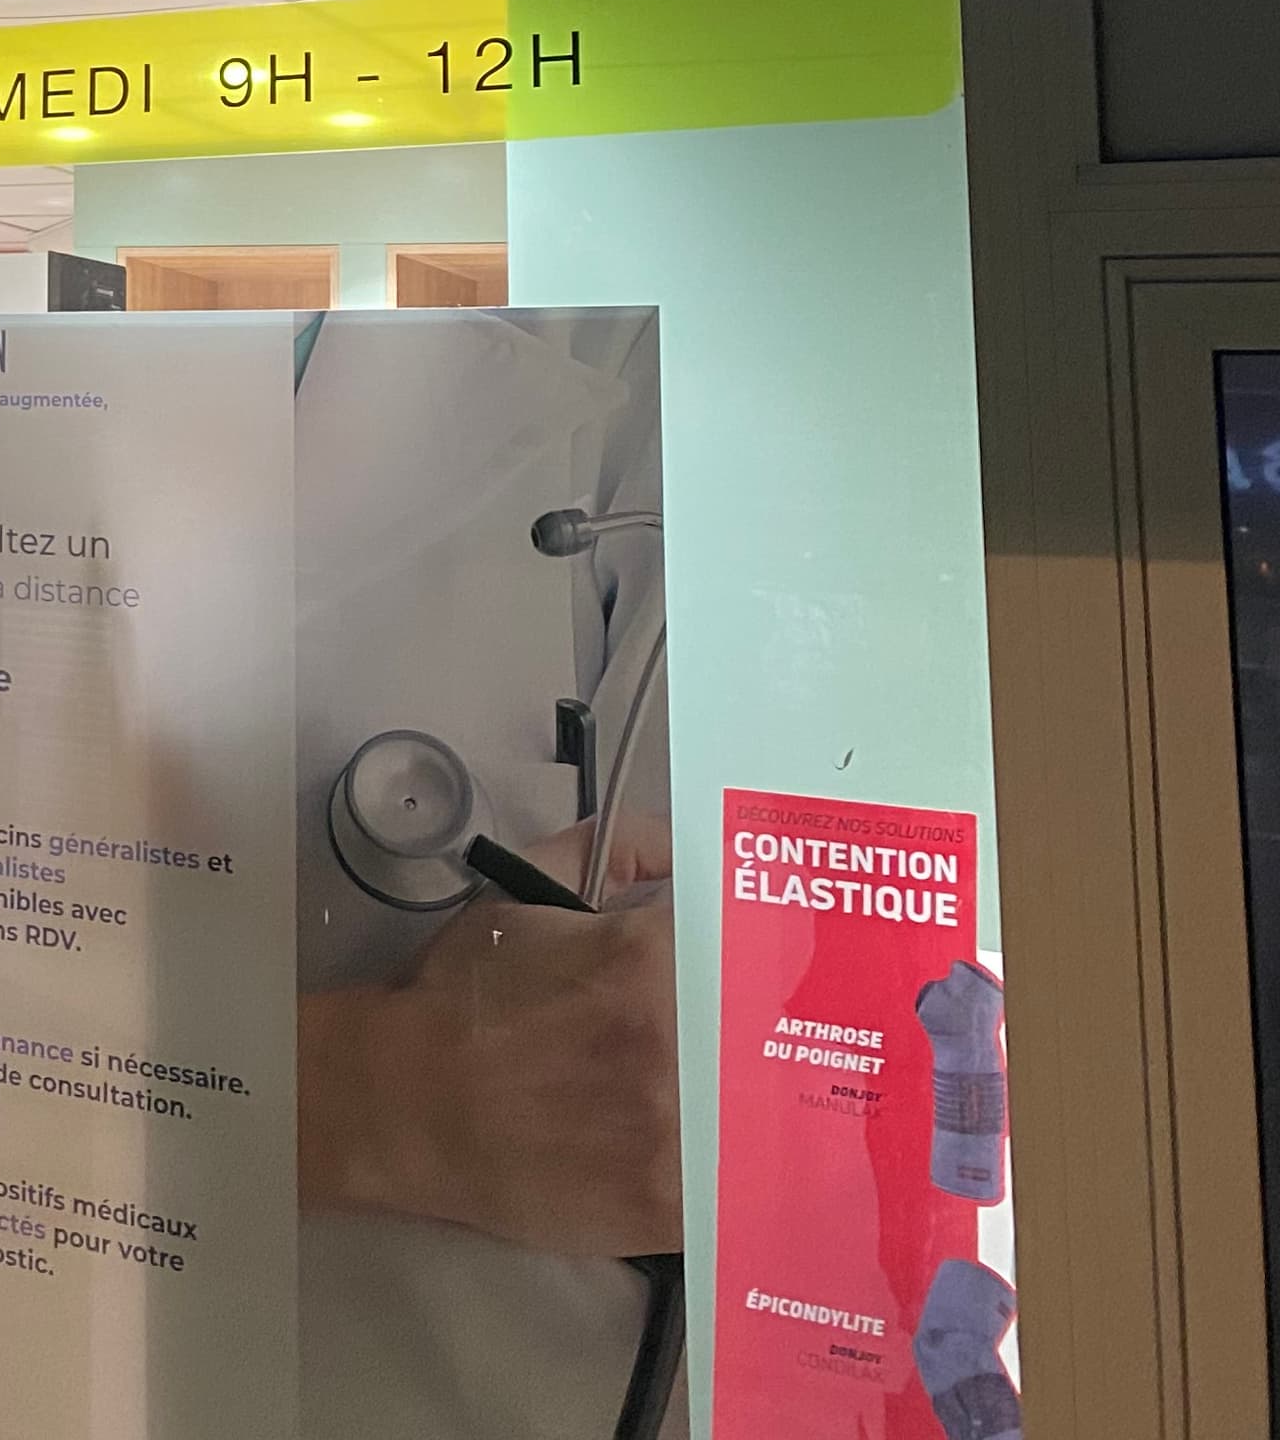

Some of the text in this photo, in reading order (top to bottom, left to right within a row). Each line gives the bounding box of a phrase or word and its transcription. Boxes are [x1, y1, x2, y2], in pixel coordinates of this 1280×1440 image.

[216, 51, 314, 109] 9H
[356, 72, 380, 81] -
[426, 29, 584, 97] 12H
[67, 534, 111, 560] un
[13, 575, 141, 608] distance
[736, 804, 966, 845] DÉCOUVREZ NOS SOLUTIONS
[48, 833, 201, 871] généralistes
[207, 853, 234, 874] et
[734, 830, 959, 885] CONTENTION
[70, 902, 128, 926] avec
[734, 860, 959, 928] ÉLASTIQUE
[25, 924, 82, 952] RDV.
[774, 1016, 885, 1050] ARTHROSE
[80, 1046, 101, 1069] si
[107, 1053, 251, 1097] nécessaire.
[762, 1039, 886, 1076] DU POIGNET
[28, 1073, 193, 1120] consultation.
[830, 1084, 884, 1103] DONJOY
[72, 1195, 199, 1242] médicaux
[52, 1225, 112, 1256] pour
[117, 1240, 185, 1273] votre
[744, 1287, 886, 1338] ÉPICONDYLITE
